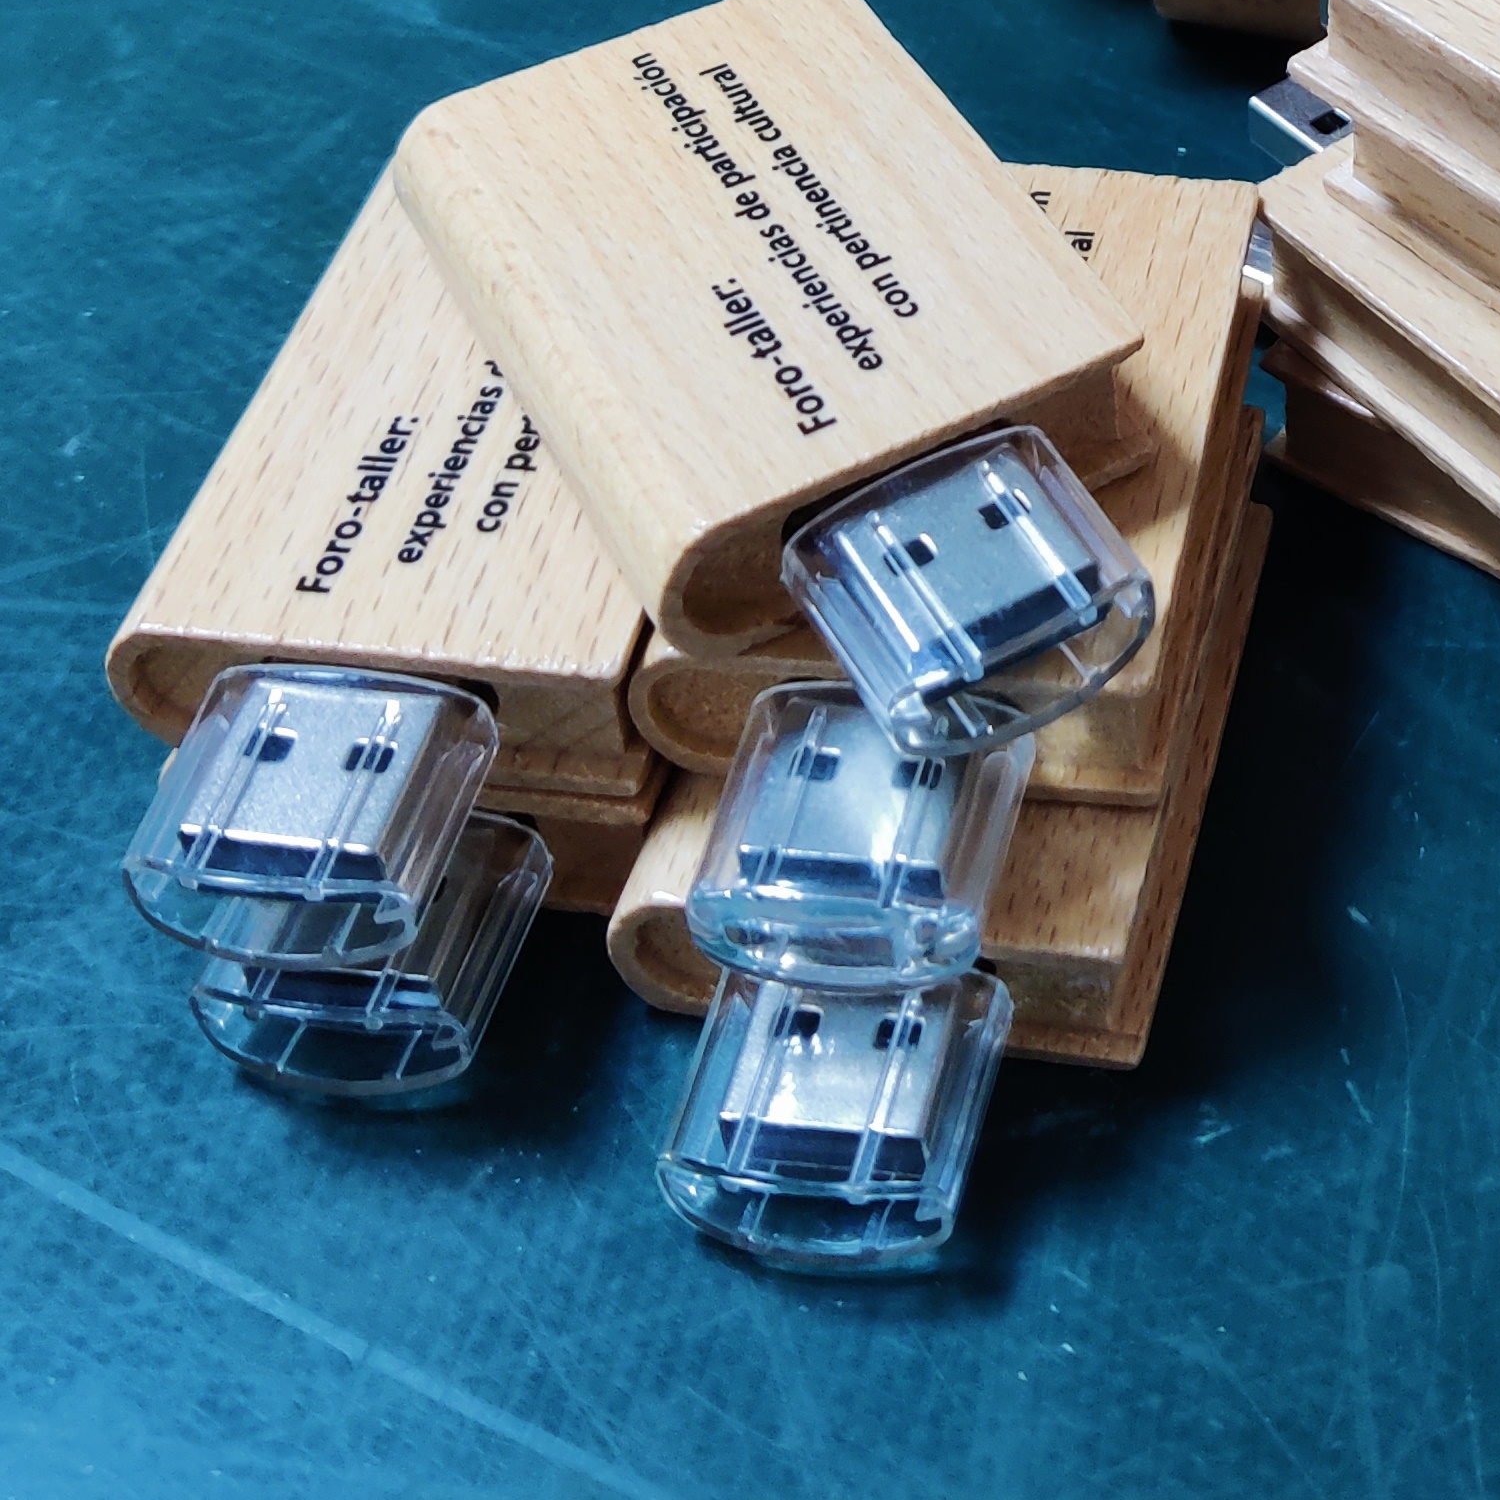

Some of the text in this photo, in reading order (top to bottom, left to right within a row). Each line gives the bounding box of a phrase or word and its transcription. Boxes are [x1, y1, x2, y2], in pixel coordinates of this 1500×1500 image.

[630, 51, 884, 372] experiencias de participación
[698, 62, 920, 319] con pertinencia cultural
[710, 277, 838, 437] Foro-taller:
[296, 415, 420, 594] Foro-taller:
[396, 385, 504, 565] experiencias
[475, 480, 520, 534] con
